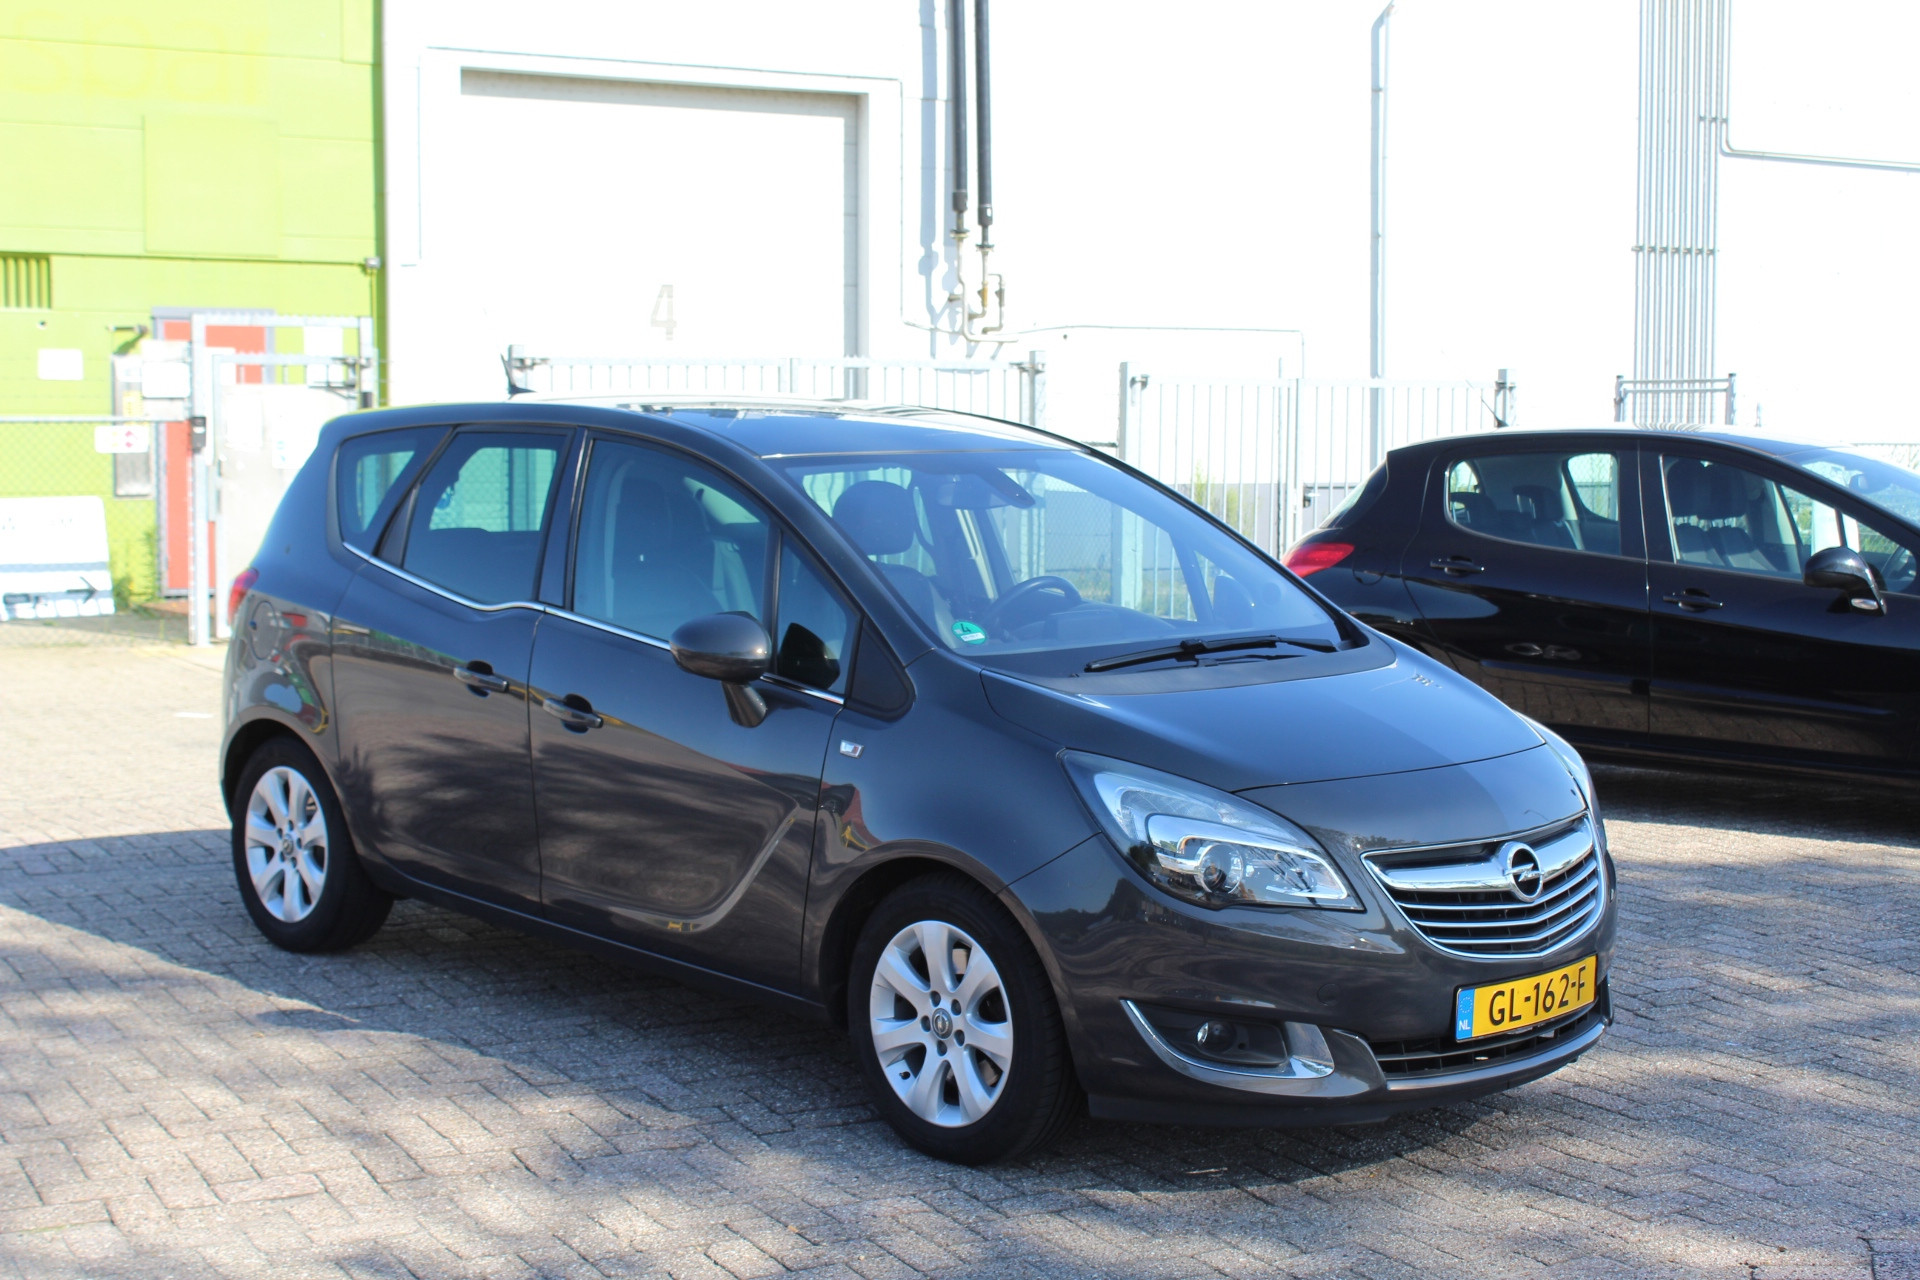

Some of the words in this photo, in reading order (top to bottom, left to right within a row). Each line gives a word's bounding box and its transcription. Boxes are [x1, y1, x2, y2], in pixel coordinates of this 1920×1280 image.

[651, 284, 677, 340] 4
[960, 623, 972, 633] 4
[1489, 965, 1586, 1026] GL-162-F
[1458, 1019, 1471, 1031] NL
